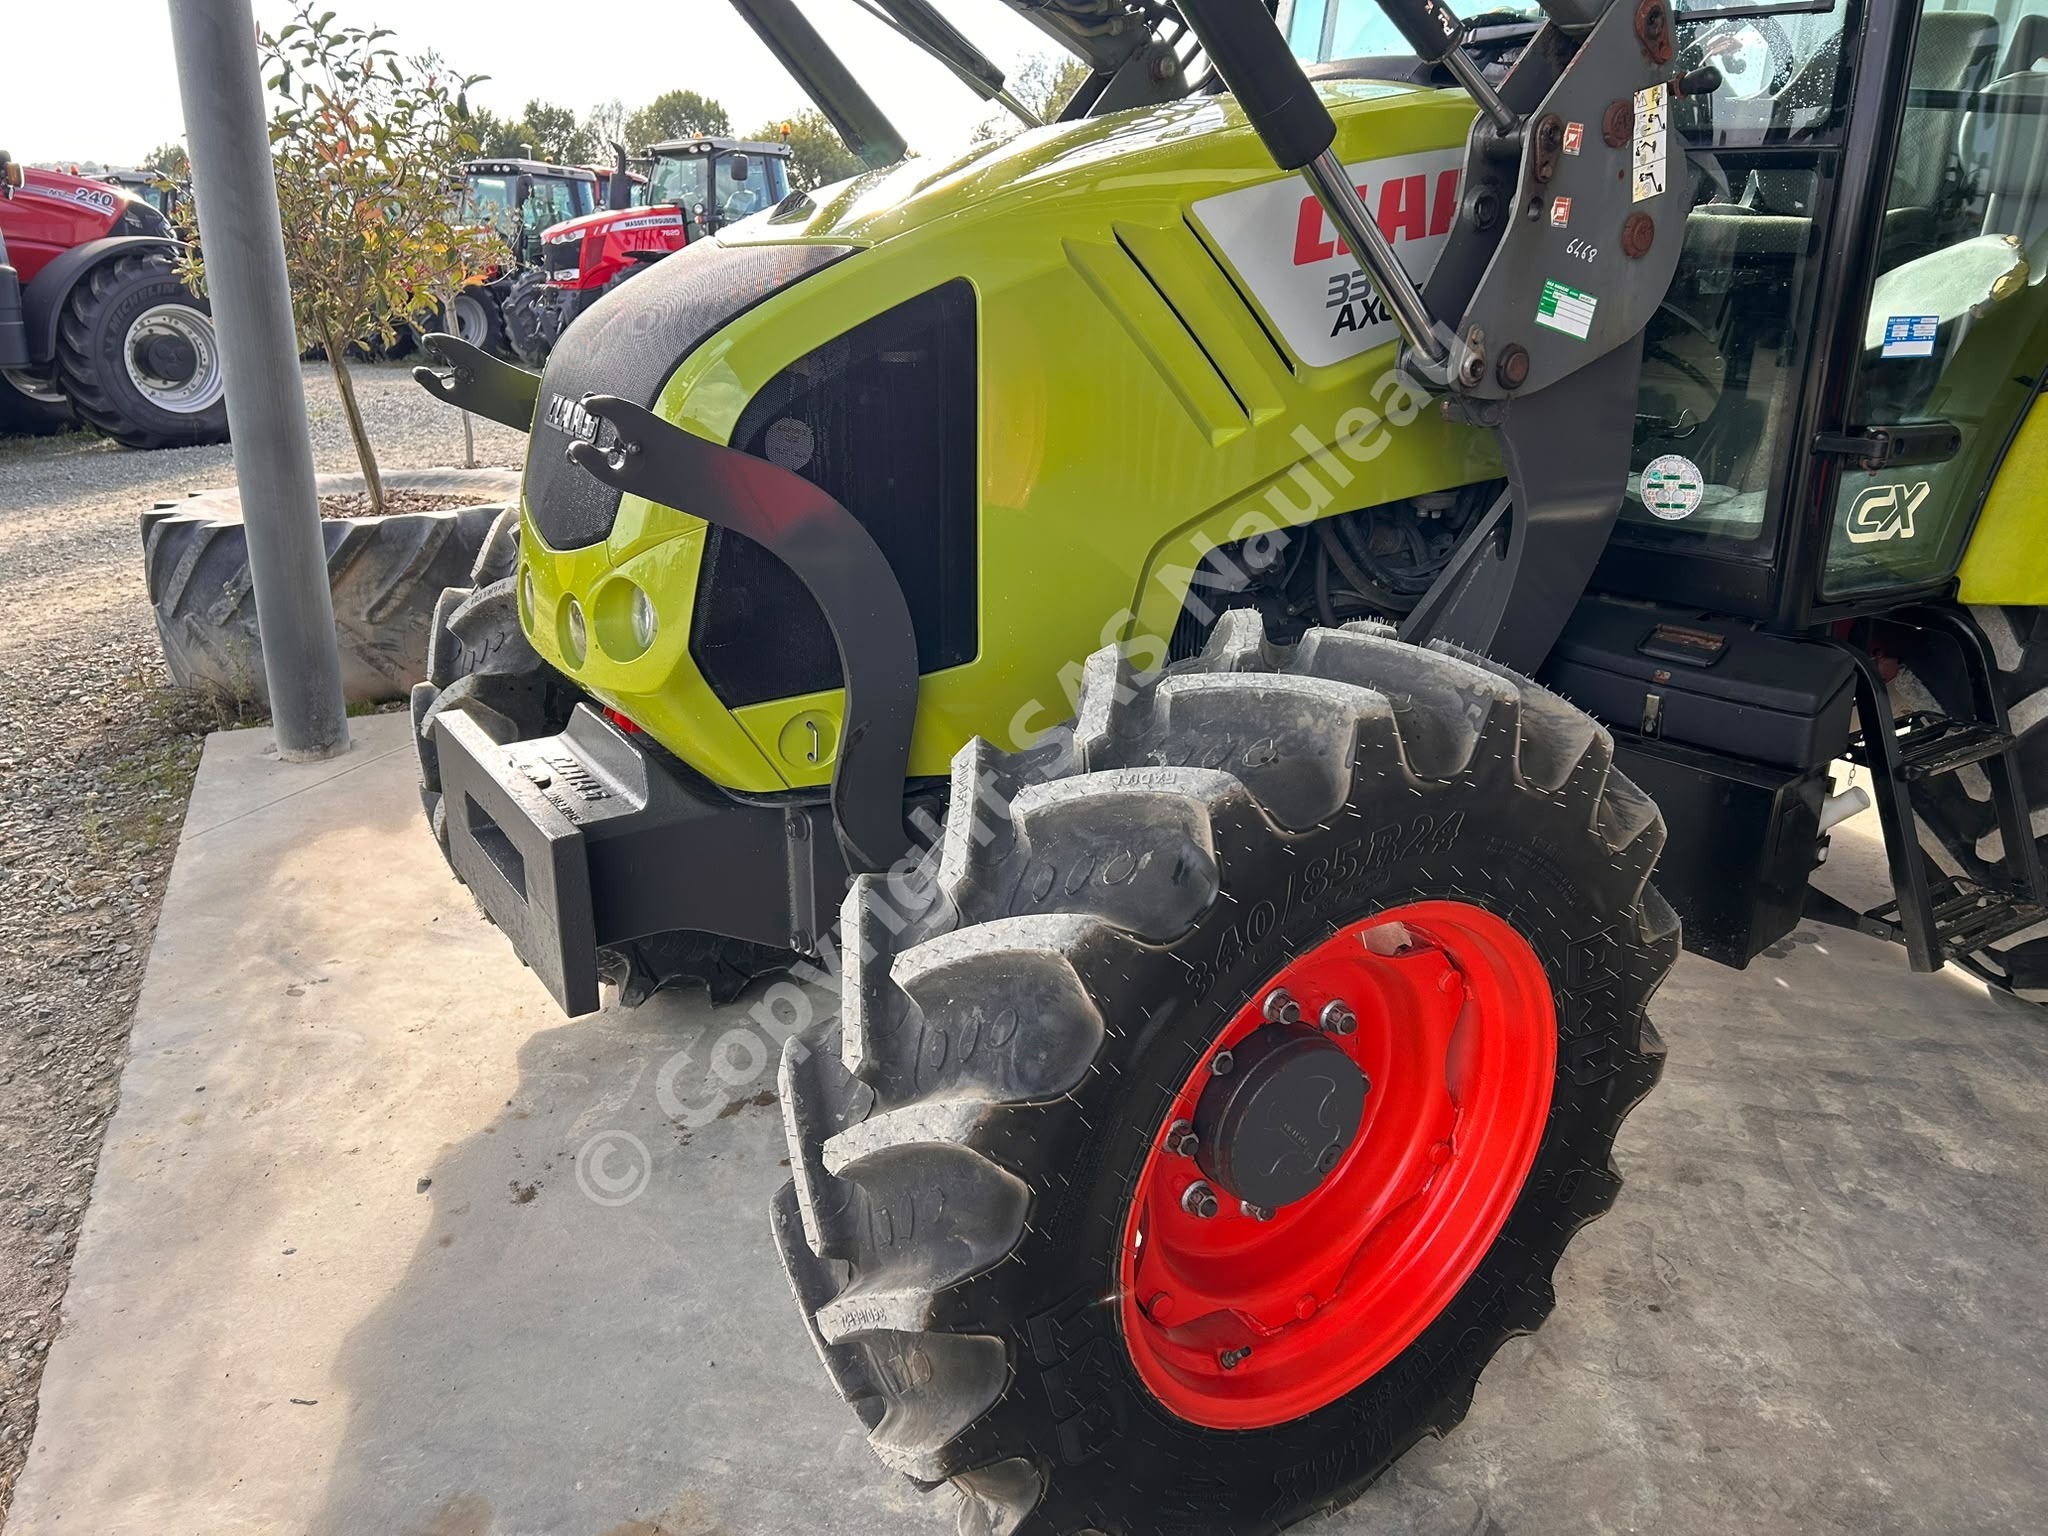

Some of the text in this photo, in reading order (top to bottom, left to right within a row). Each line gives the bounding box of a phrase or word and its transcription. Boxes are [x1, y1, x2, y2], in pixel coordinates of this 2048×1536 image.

[75, 188, 113, 207] 240
[624, 216, 678, 228] MASSEY FERGUSON
[1566, 238, 1598, 263] 6468
[1326, 268, 1376, 309] 33
[108, 282, 176, 336] MICHELIN
[1846, 482, 1930, 543] CX
[1111, 771, 1178, 787] RADIAL
